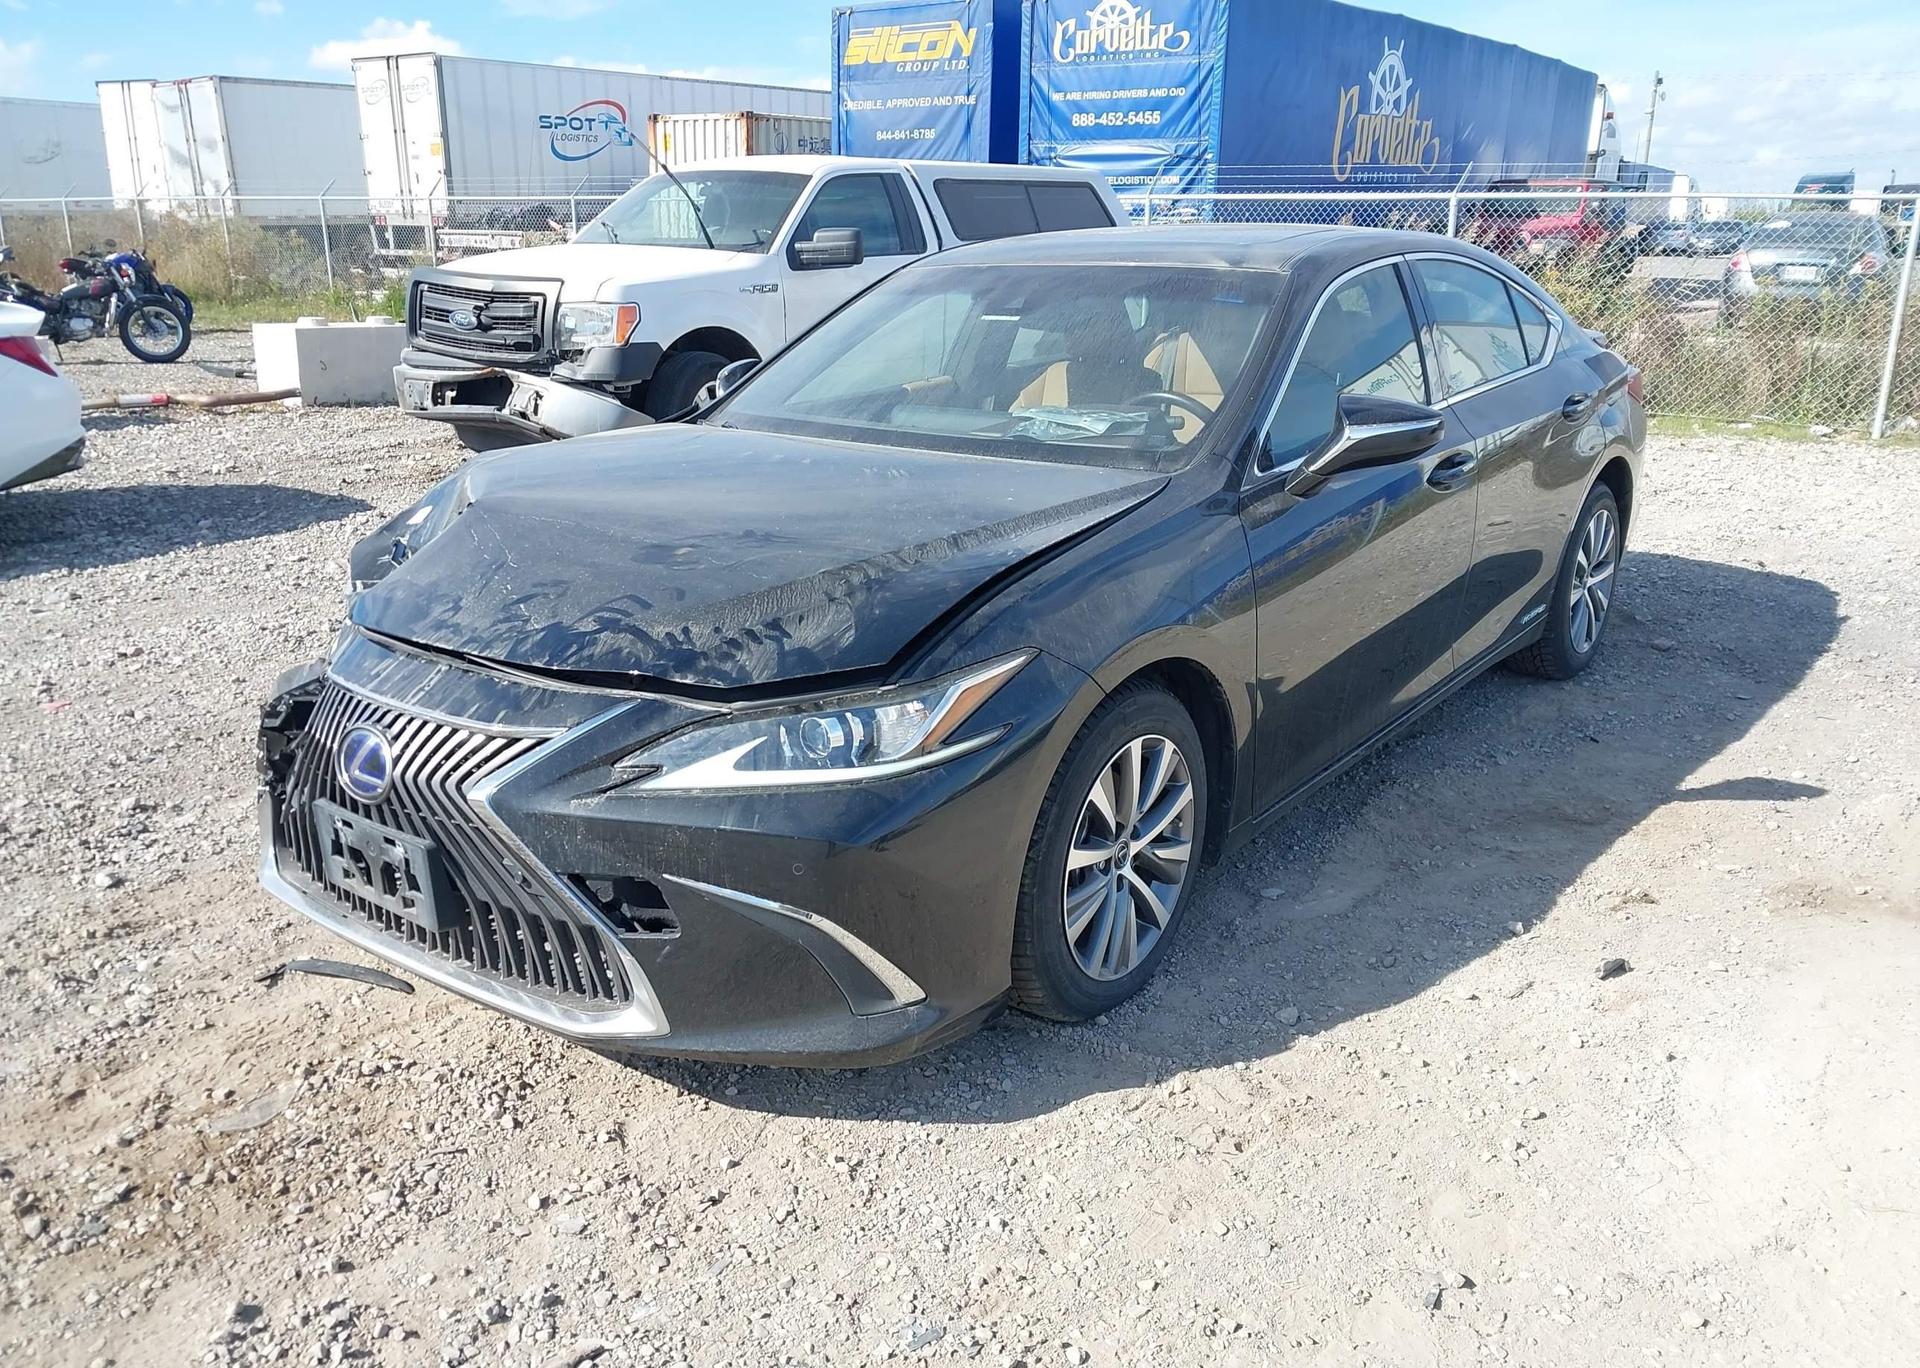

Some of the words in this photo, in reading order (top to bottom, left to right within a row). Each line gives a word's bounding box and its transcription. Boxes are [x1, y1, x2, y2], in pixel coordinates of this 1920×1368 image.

[1053, 9, 1191, 63] Corvette
[896, 62, 940, 73] GROUP
[943, 59, 971, 71] LTD.
[886, 97, 931, 109] APPROVED
[931, 95, 953, 106] AND
[953, 94, 977, 105] TRUE
[1052, 92, 1065, 101] WE
[1066, 91, 1082, 100] ARE
[1083, 90, 1111, 100] HIRING
[1112, 88, 1148, 99] DRIVERS
[1149, 88, 1168, 97] AND
[1169, 87, 1186, 96] O/O
[539, 115, 596, 131] SPOT
[1071, 110, 1161, 126] 888-452-5455
[555, 132, 599, 143] LOGISTICS
[1332, 85, 1440, 182] Corvette
